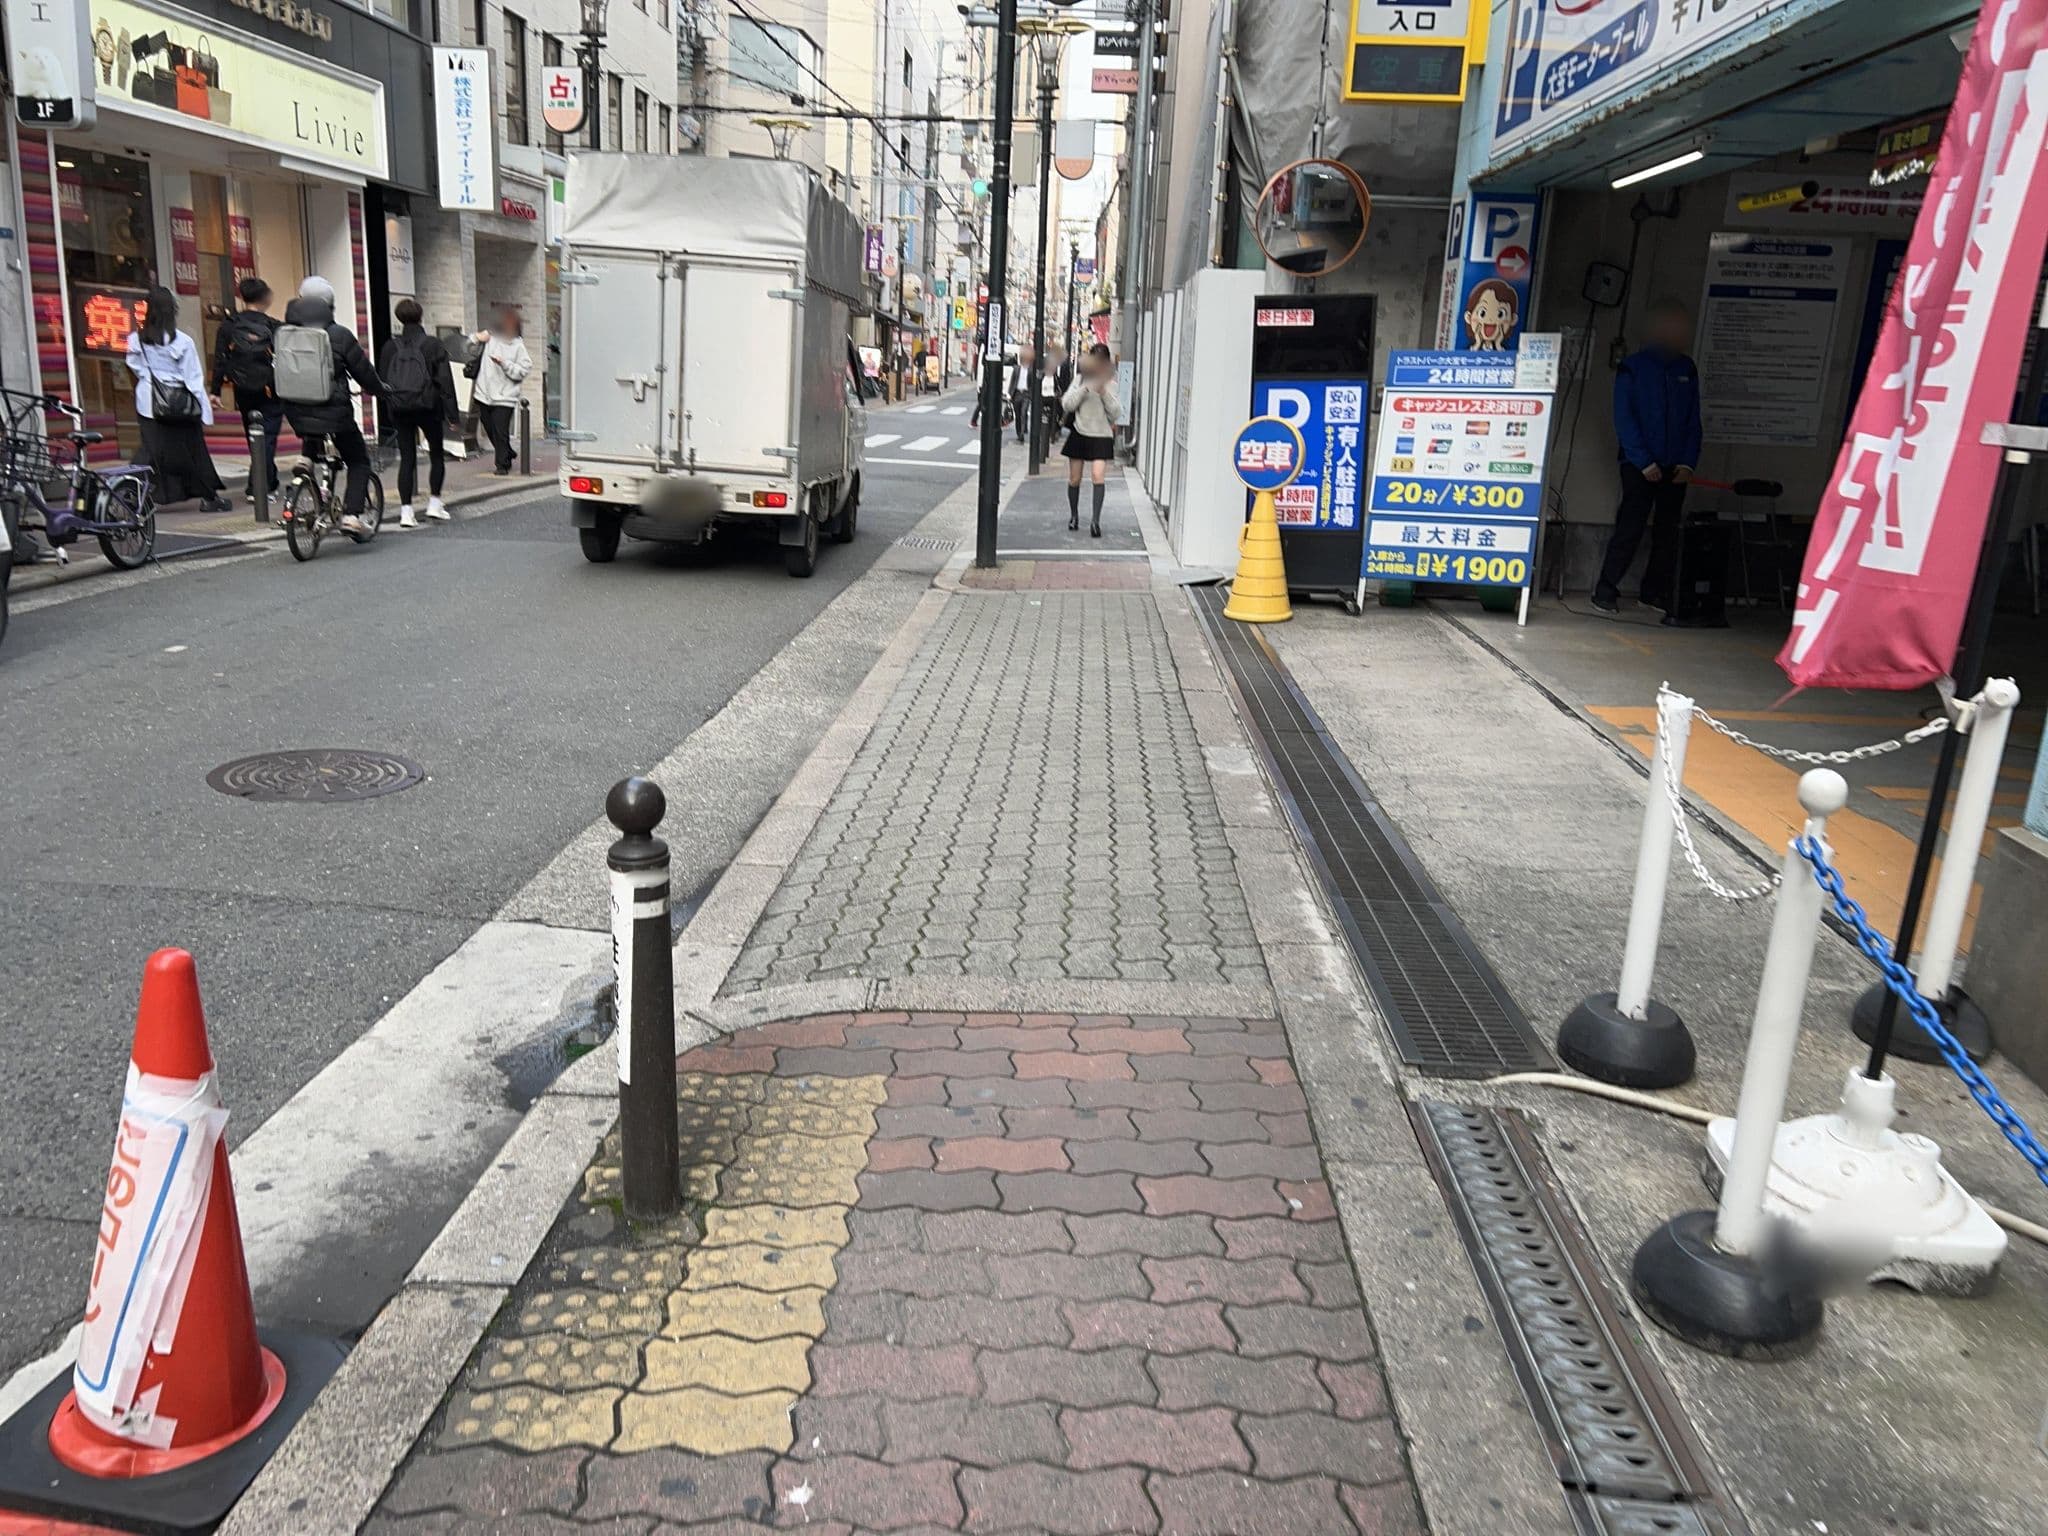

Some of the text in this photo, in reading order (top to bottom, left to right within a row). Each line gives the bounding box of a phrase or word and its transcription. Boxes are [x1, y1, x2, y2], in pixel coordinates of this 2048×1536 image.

[1389, 10, 1436, 31] 入口
[1545, 8, 1650, 103] 大宝モータープール
[550, 74, 570, 98] 占
[37, 102, 54, 118] 1F
[293, 101, 363, 156] Livie
[172, 218, 194, 238] SALE
[1450, 206, 1463, 257] P
[1484, 207, 1520, 257] P
[176, 261, 198, 281] SALE
[1428, 368, 1515, 384] 24時間営業
[1330, 390, 1357, 403] 安心
[1329, 406, 1356, 420] 安全
[1430, 423, 1453, 431] VISA
[1238, 439, 1292, 472] 空車
[1334, 426, 1359, 527] 有人駐車場
[1401, 526, 1497, 547] 最大料金
[1432, 553, 1526, 583] ¥1900
